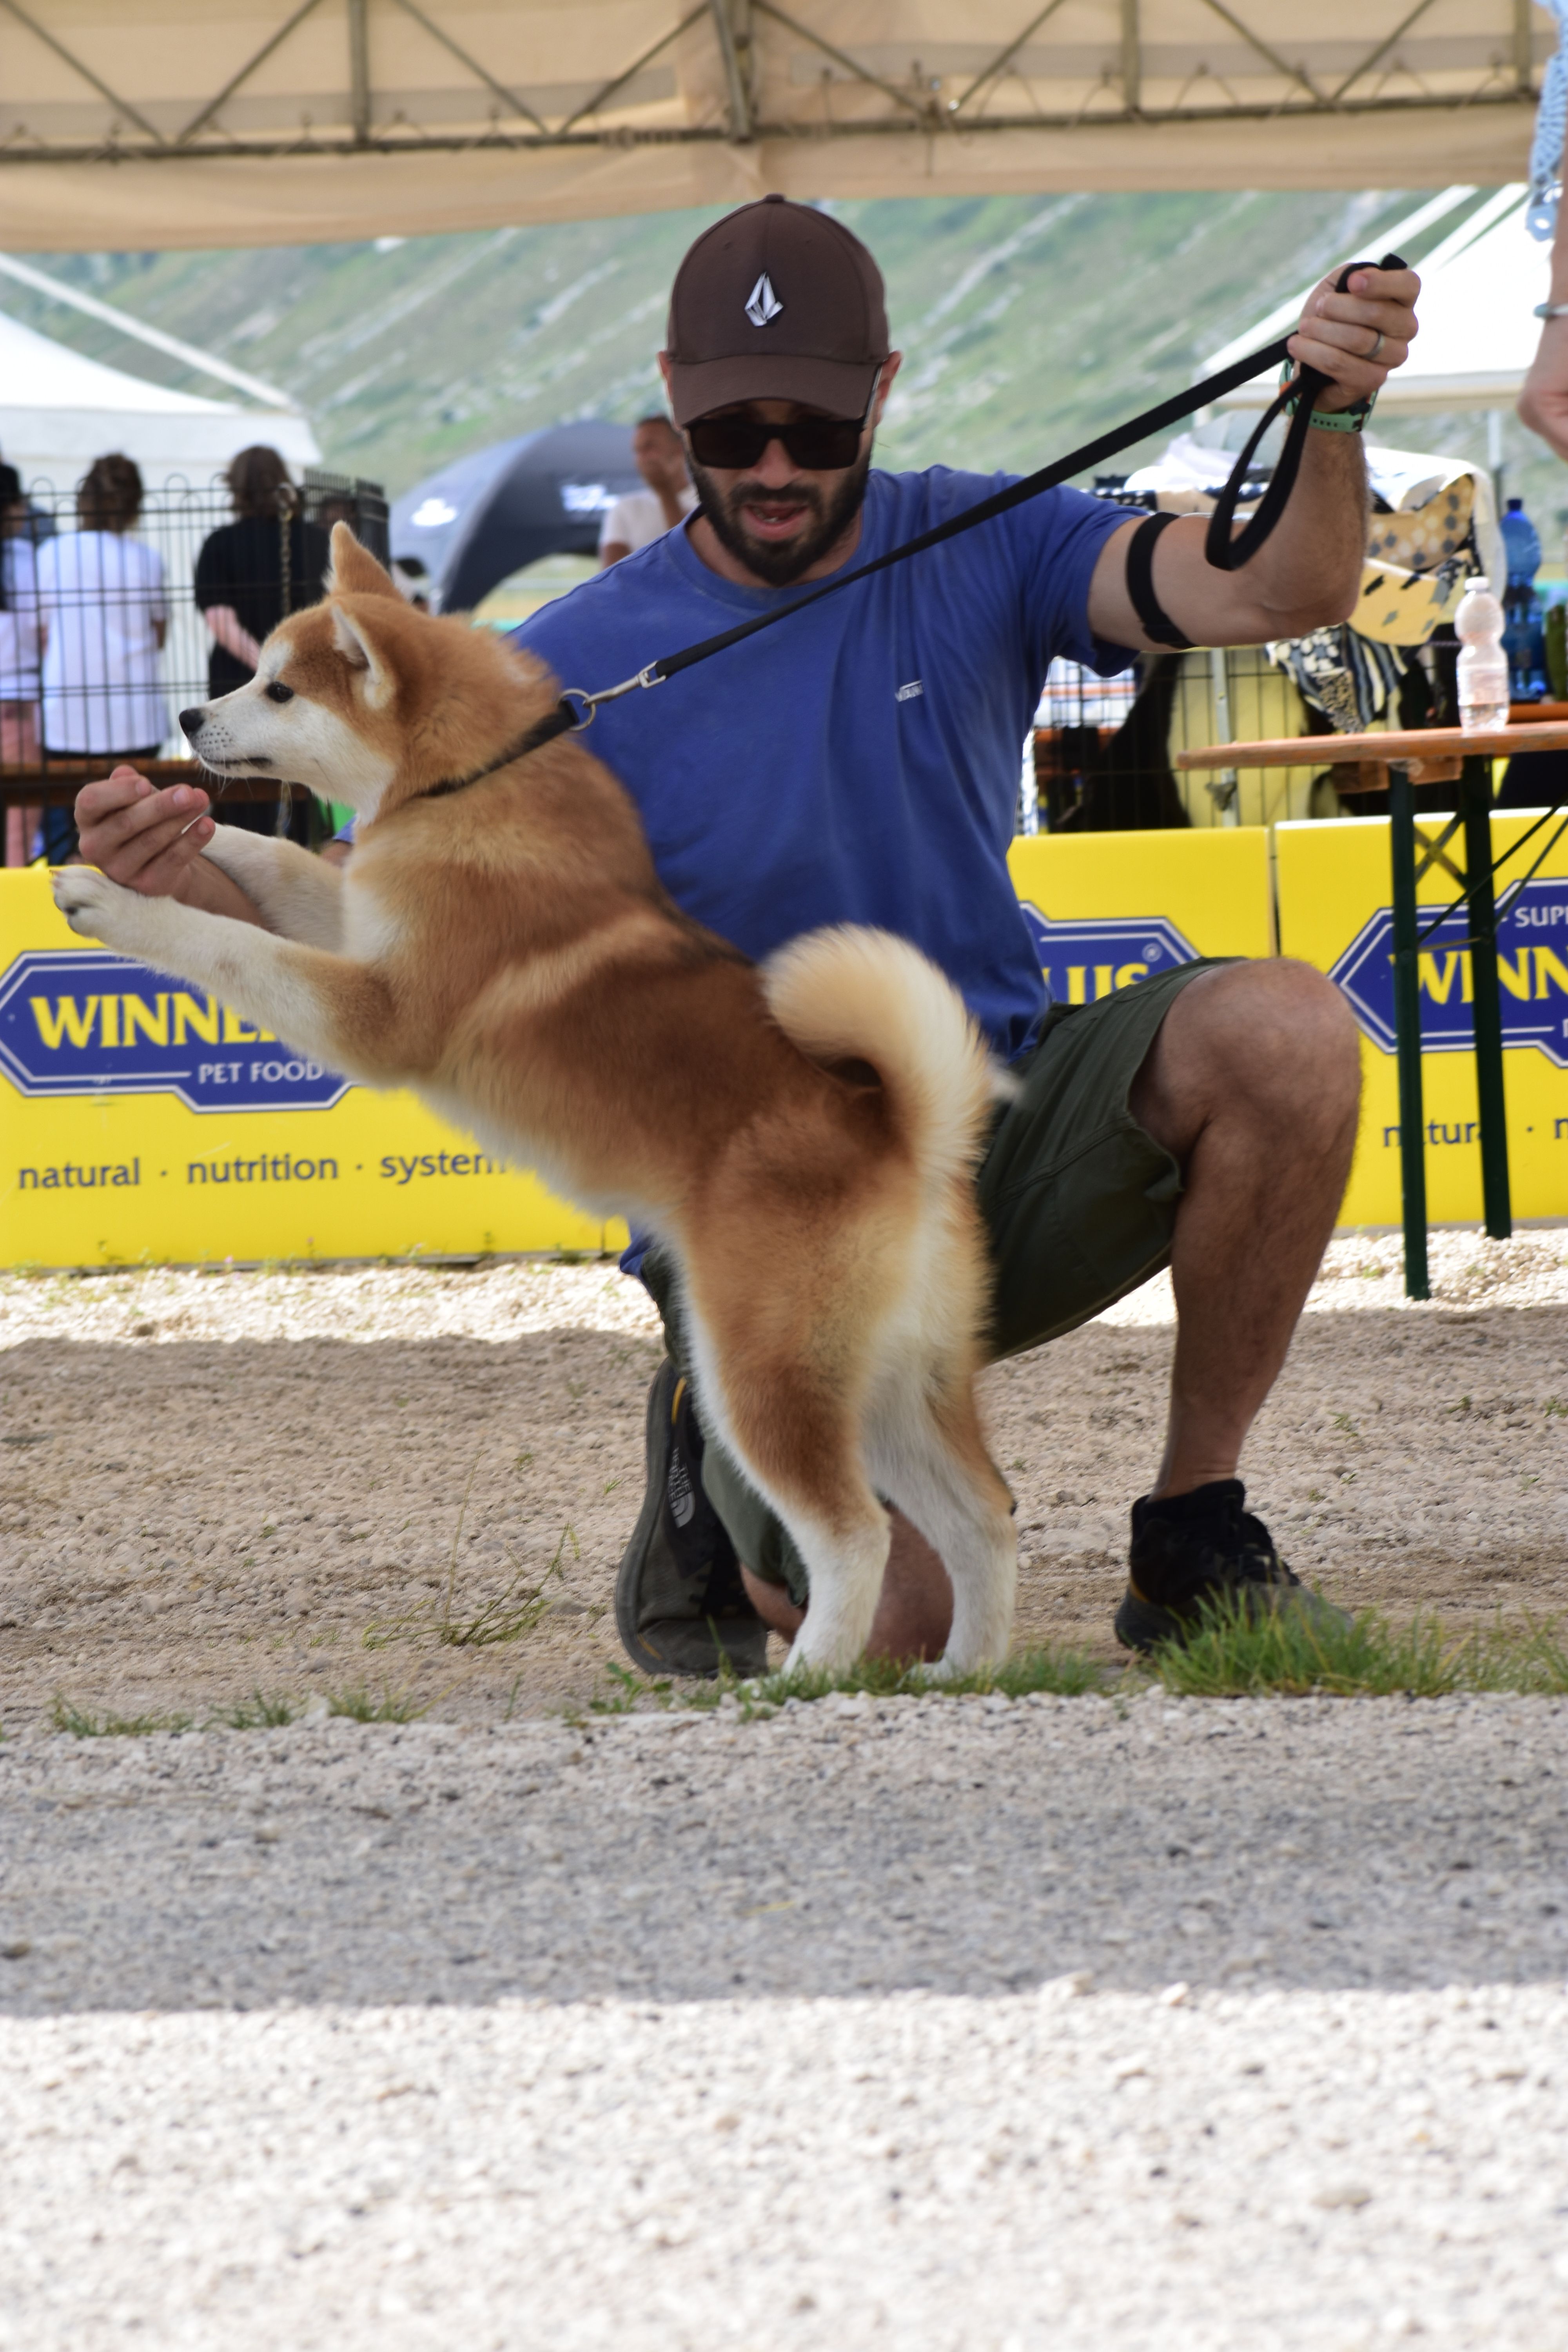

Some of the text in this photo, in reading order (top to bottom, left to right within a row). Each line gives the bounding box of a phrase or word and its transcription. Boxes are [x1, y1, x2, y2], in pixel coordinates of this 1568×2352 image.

[29, 992, 276, 1049] WINNE
[198, 1060, 325, 1084] PET FOOD
[18, 1157, 140, 1189] natural
[187, 1153, 338, 1183] nutrition
